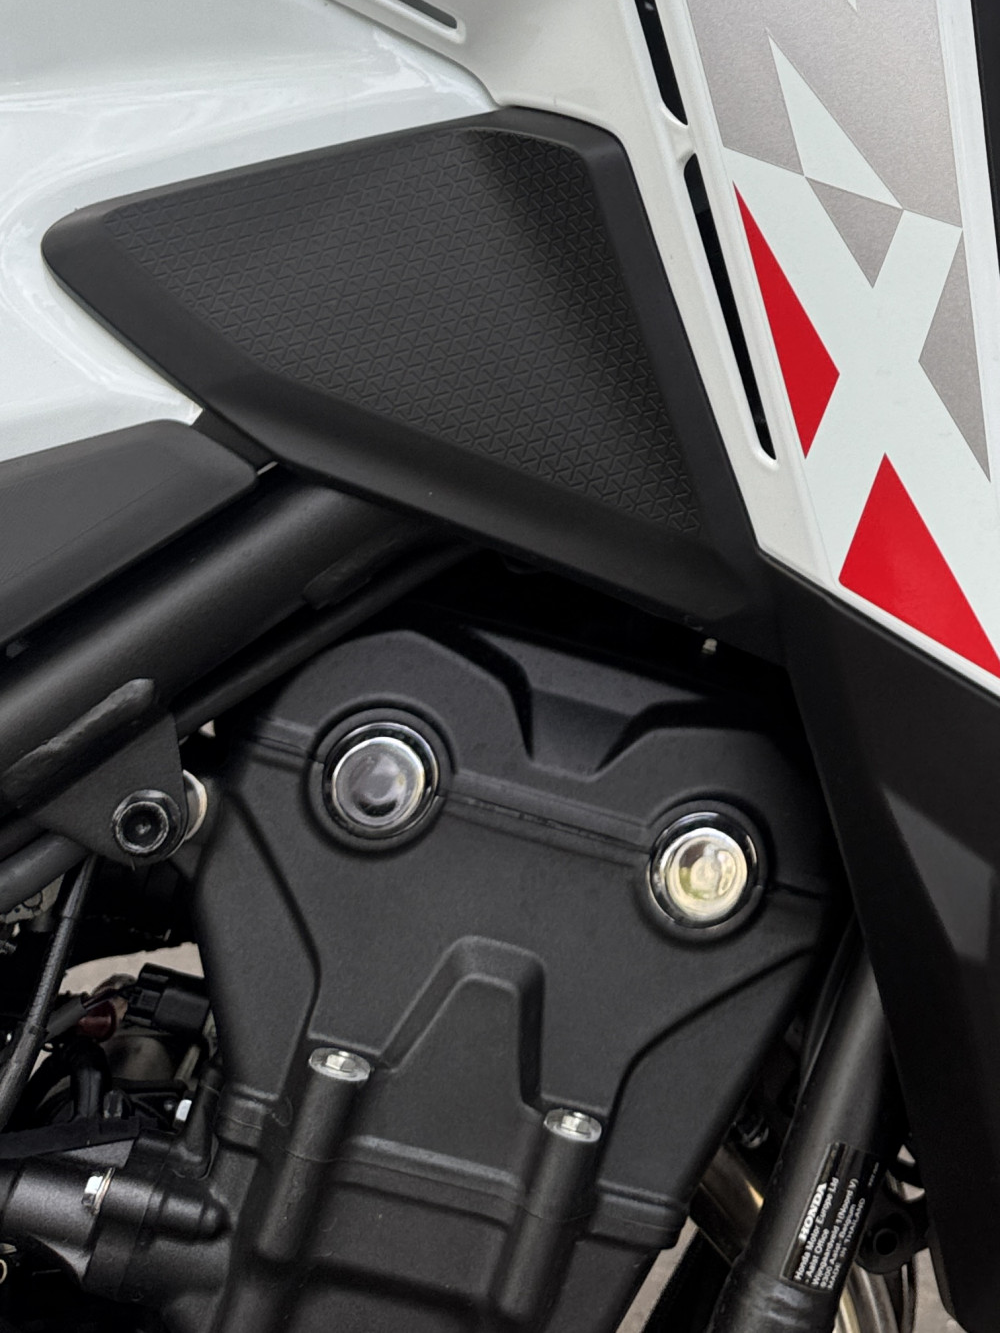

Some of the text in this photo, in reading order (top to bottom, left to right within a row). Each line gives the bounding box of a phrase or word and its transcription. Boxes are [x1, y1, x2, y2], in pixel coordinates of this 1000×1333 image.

[794, 1177, 839, 1280] Honda Motor Europe Ltd
[798, 1182, 827, 1241] HONDA
[844, 1197, 866, 1243] THAILAND
[805, 1255, 819, 1278] Aalst
[814, 1228, 829, 1254] Office
